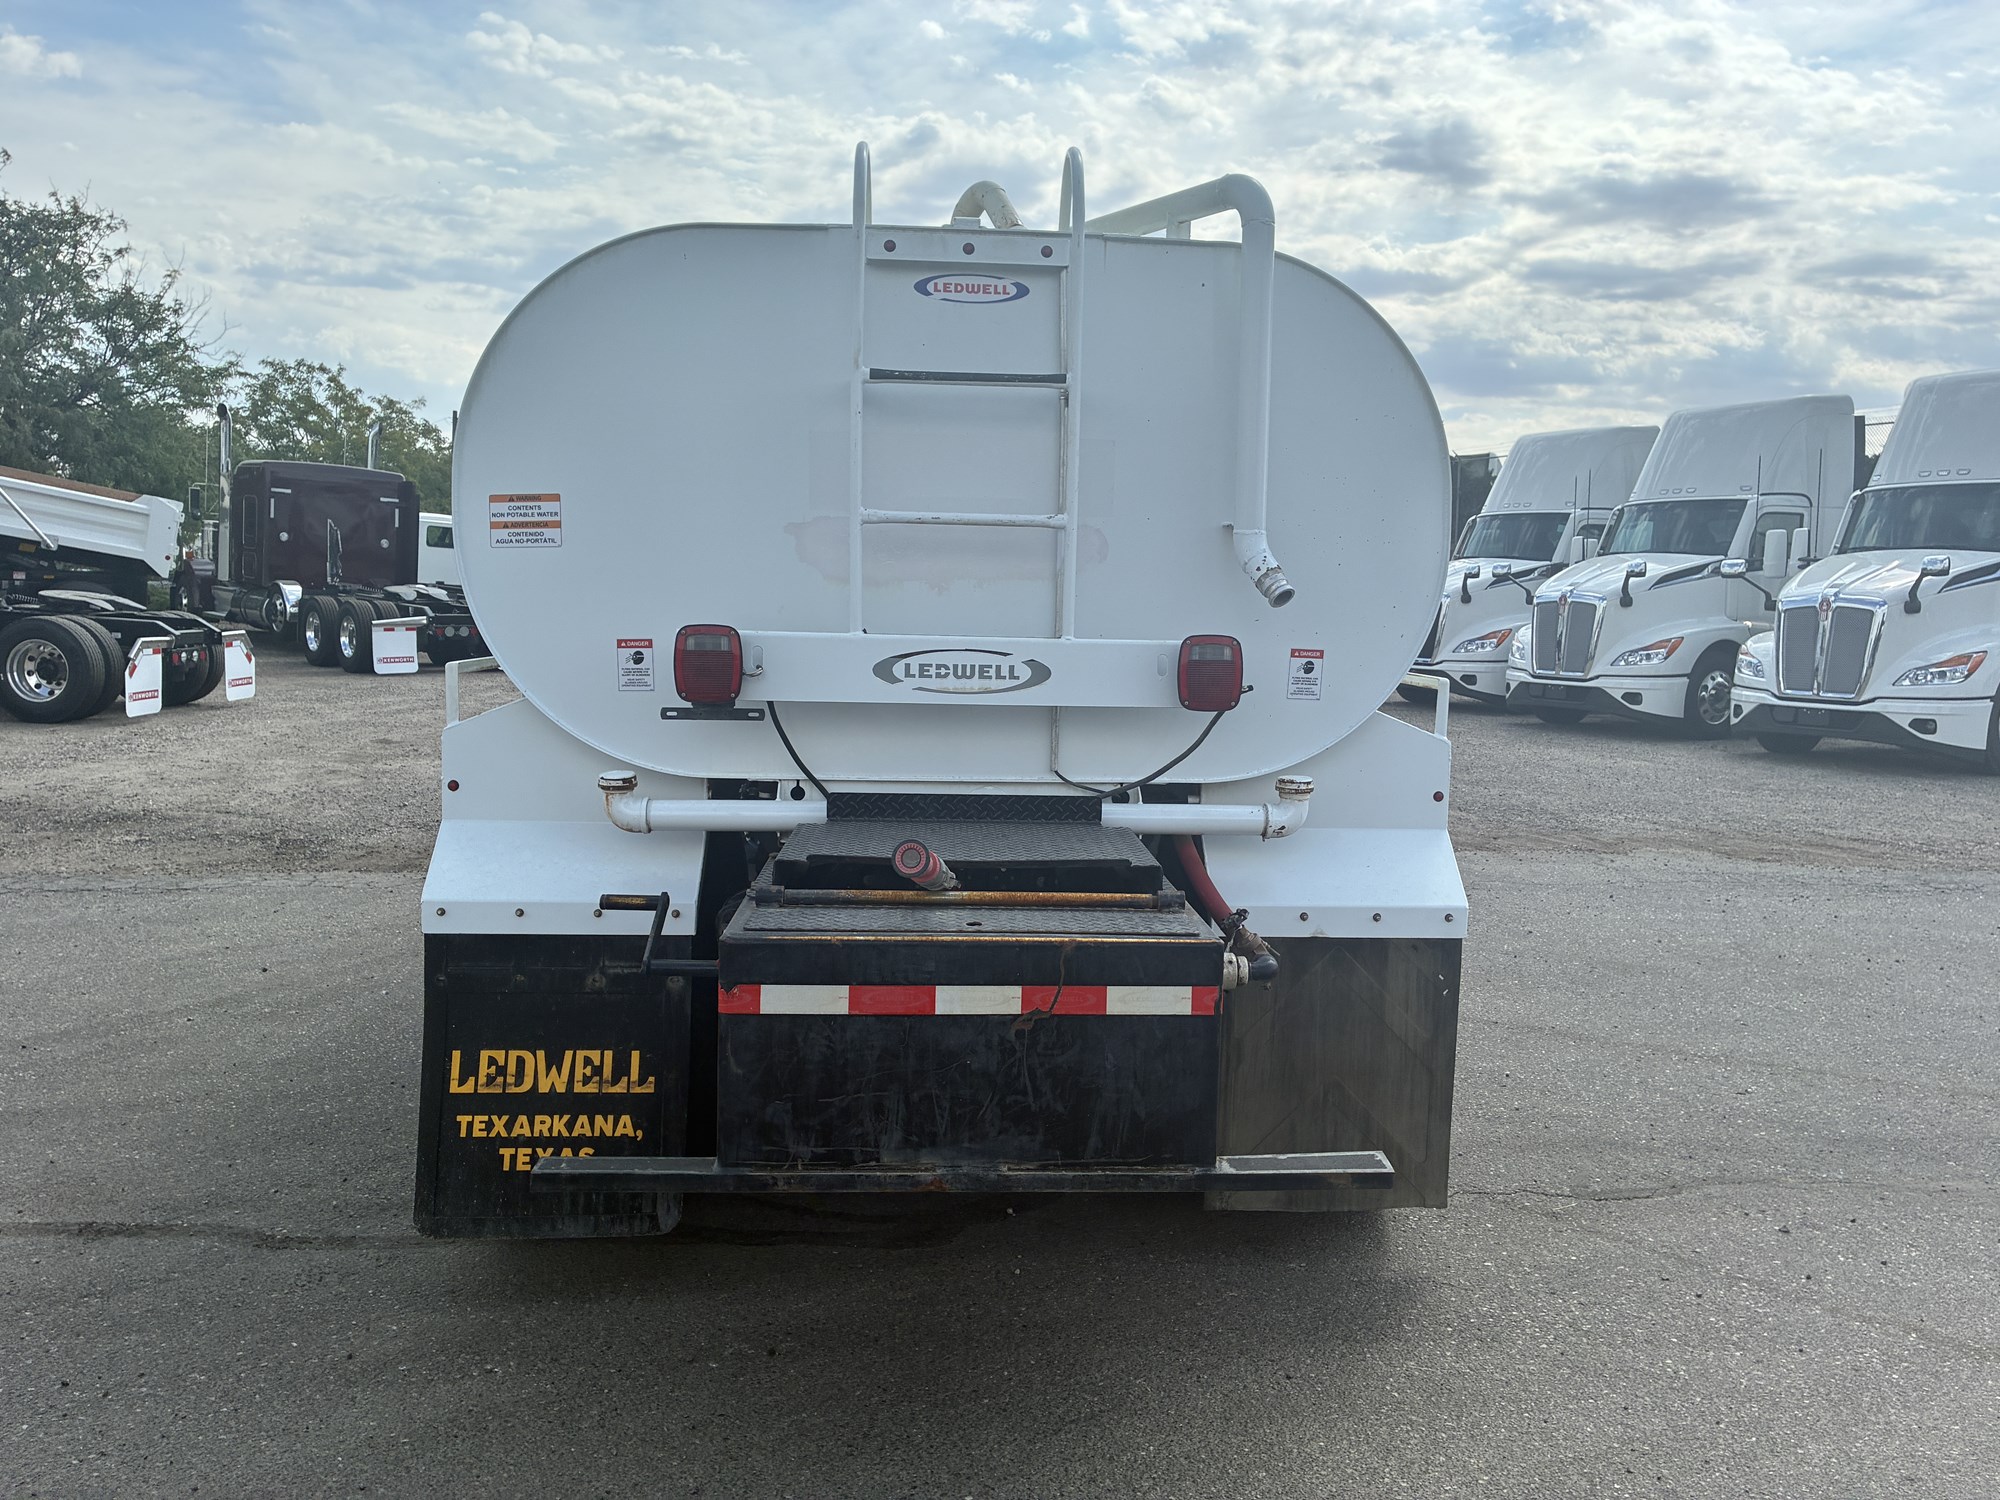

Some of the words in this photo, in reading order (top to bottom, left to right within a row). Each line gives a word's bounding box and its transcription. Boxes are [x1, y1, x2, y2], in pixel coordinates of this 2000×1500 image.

[933, 281, 1011, 296] LEDWELL
[904, 662, 1020, 681] LEDWELL
[133, 691, 159, 700] KENWORTH
[449, 1049, 655, 1094] LEDWELL
[456, 1114, 643, 1142] TEXARKANA,
